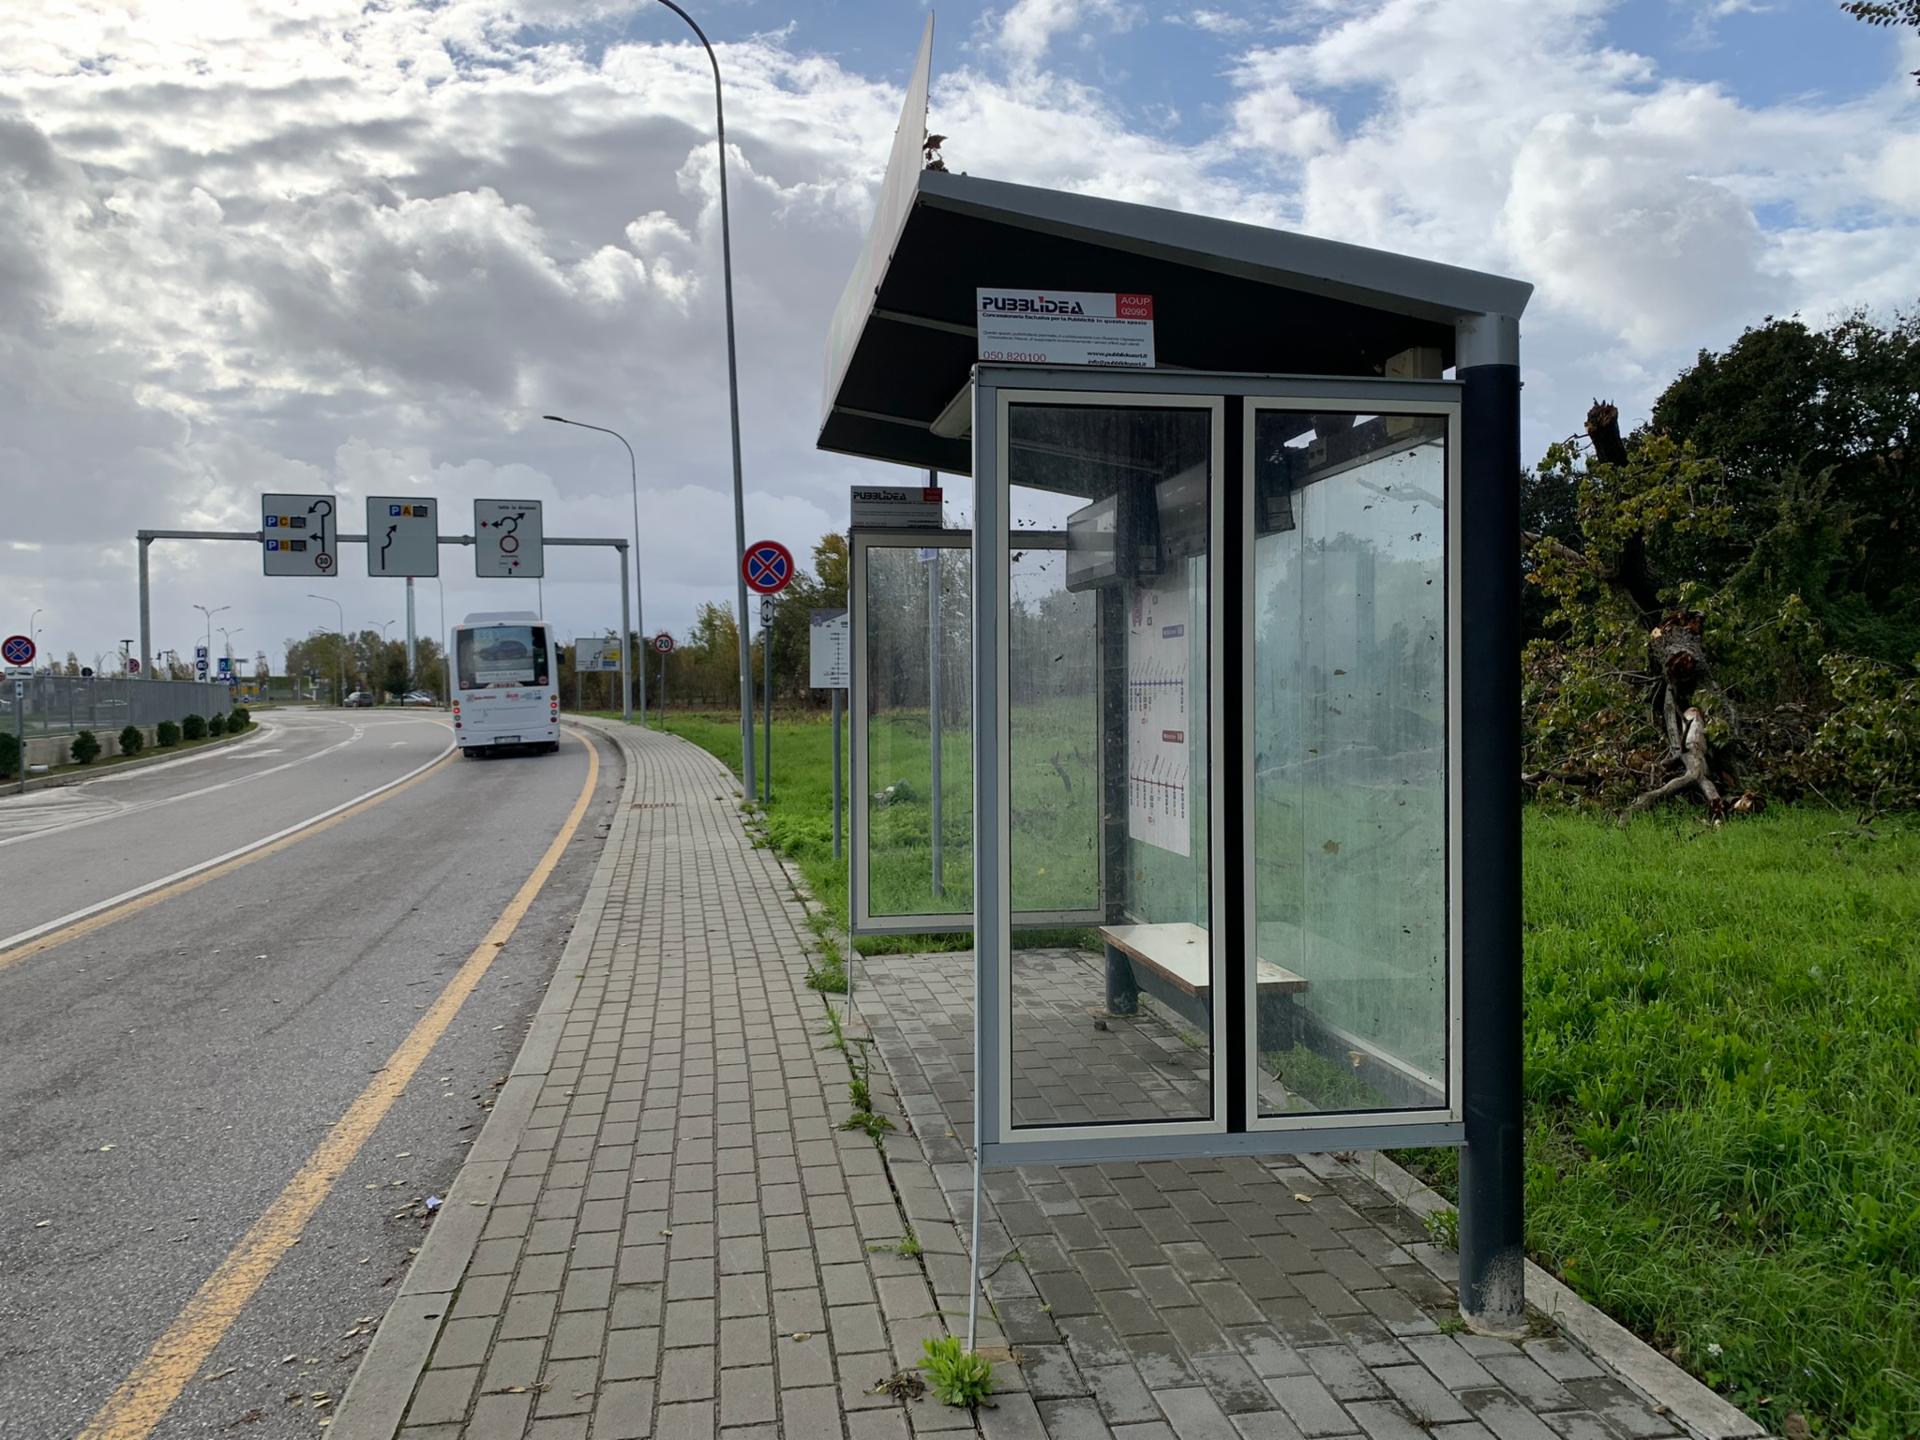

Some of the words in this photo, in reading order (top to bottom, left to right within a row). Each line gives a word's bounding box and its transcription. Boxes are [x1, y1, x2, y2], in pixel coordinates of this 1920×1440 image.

[1120, 296, 1151, 306] AOUP
[403, 506, 411, 515] A
[658, 639, 670, 649] 20
